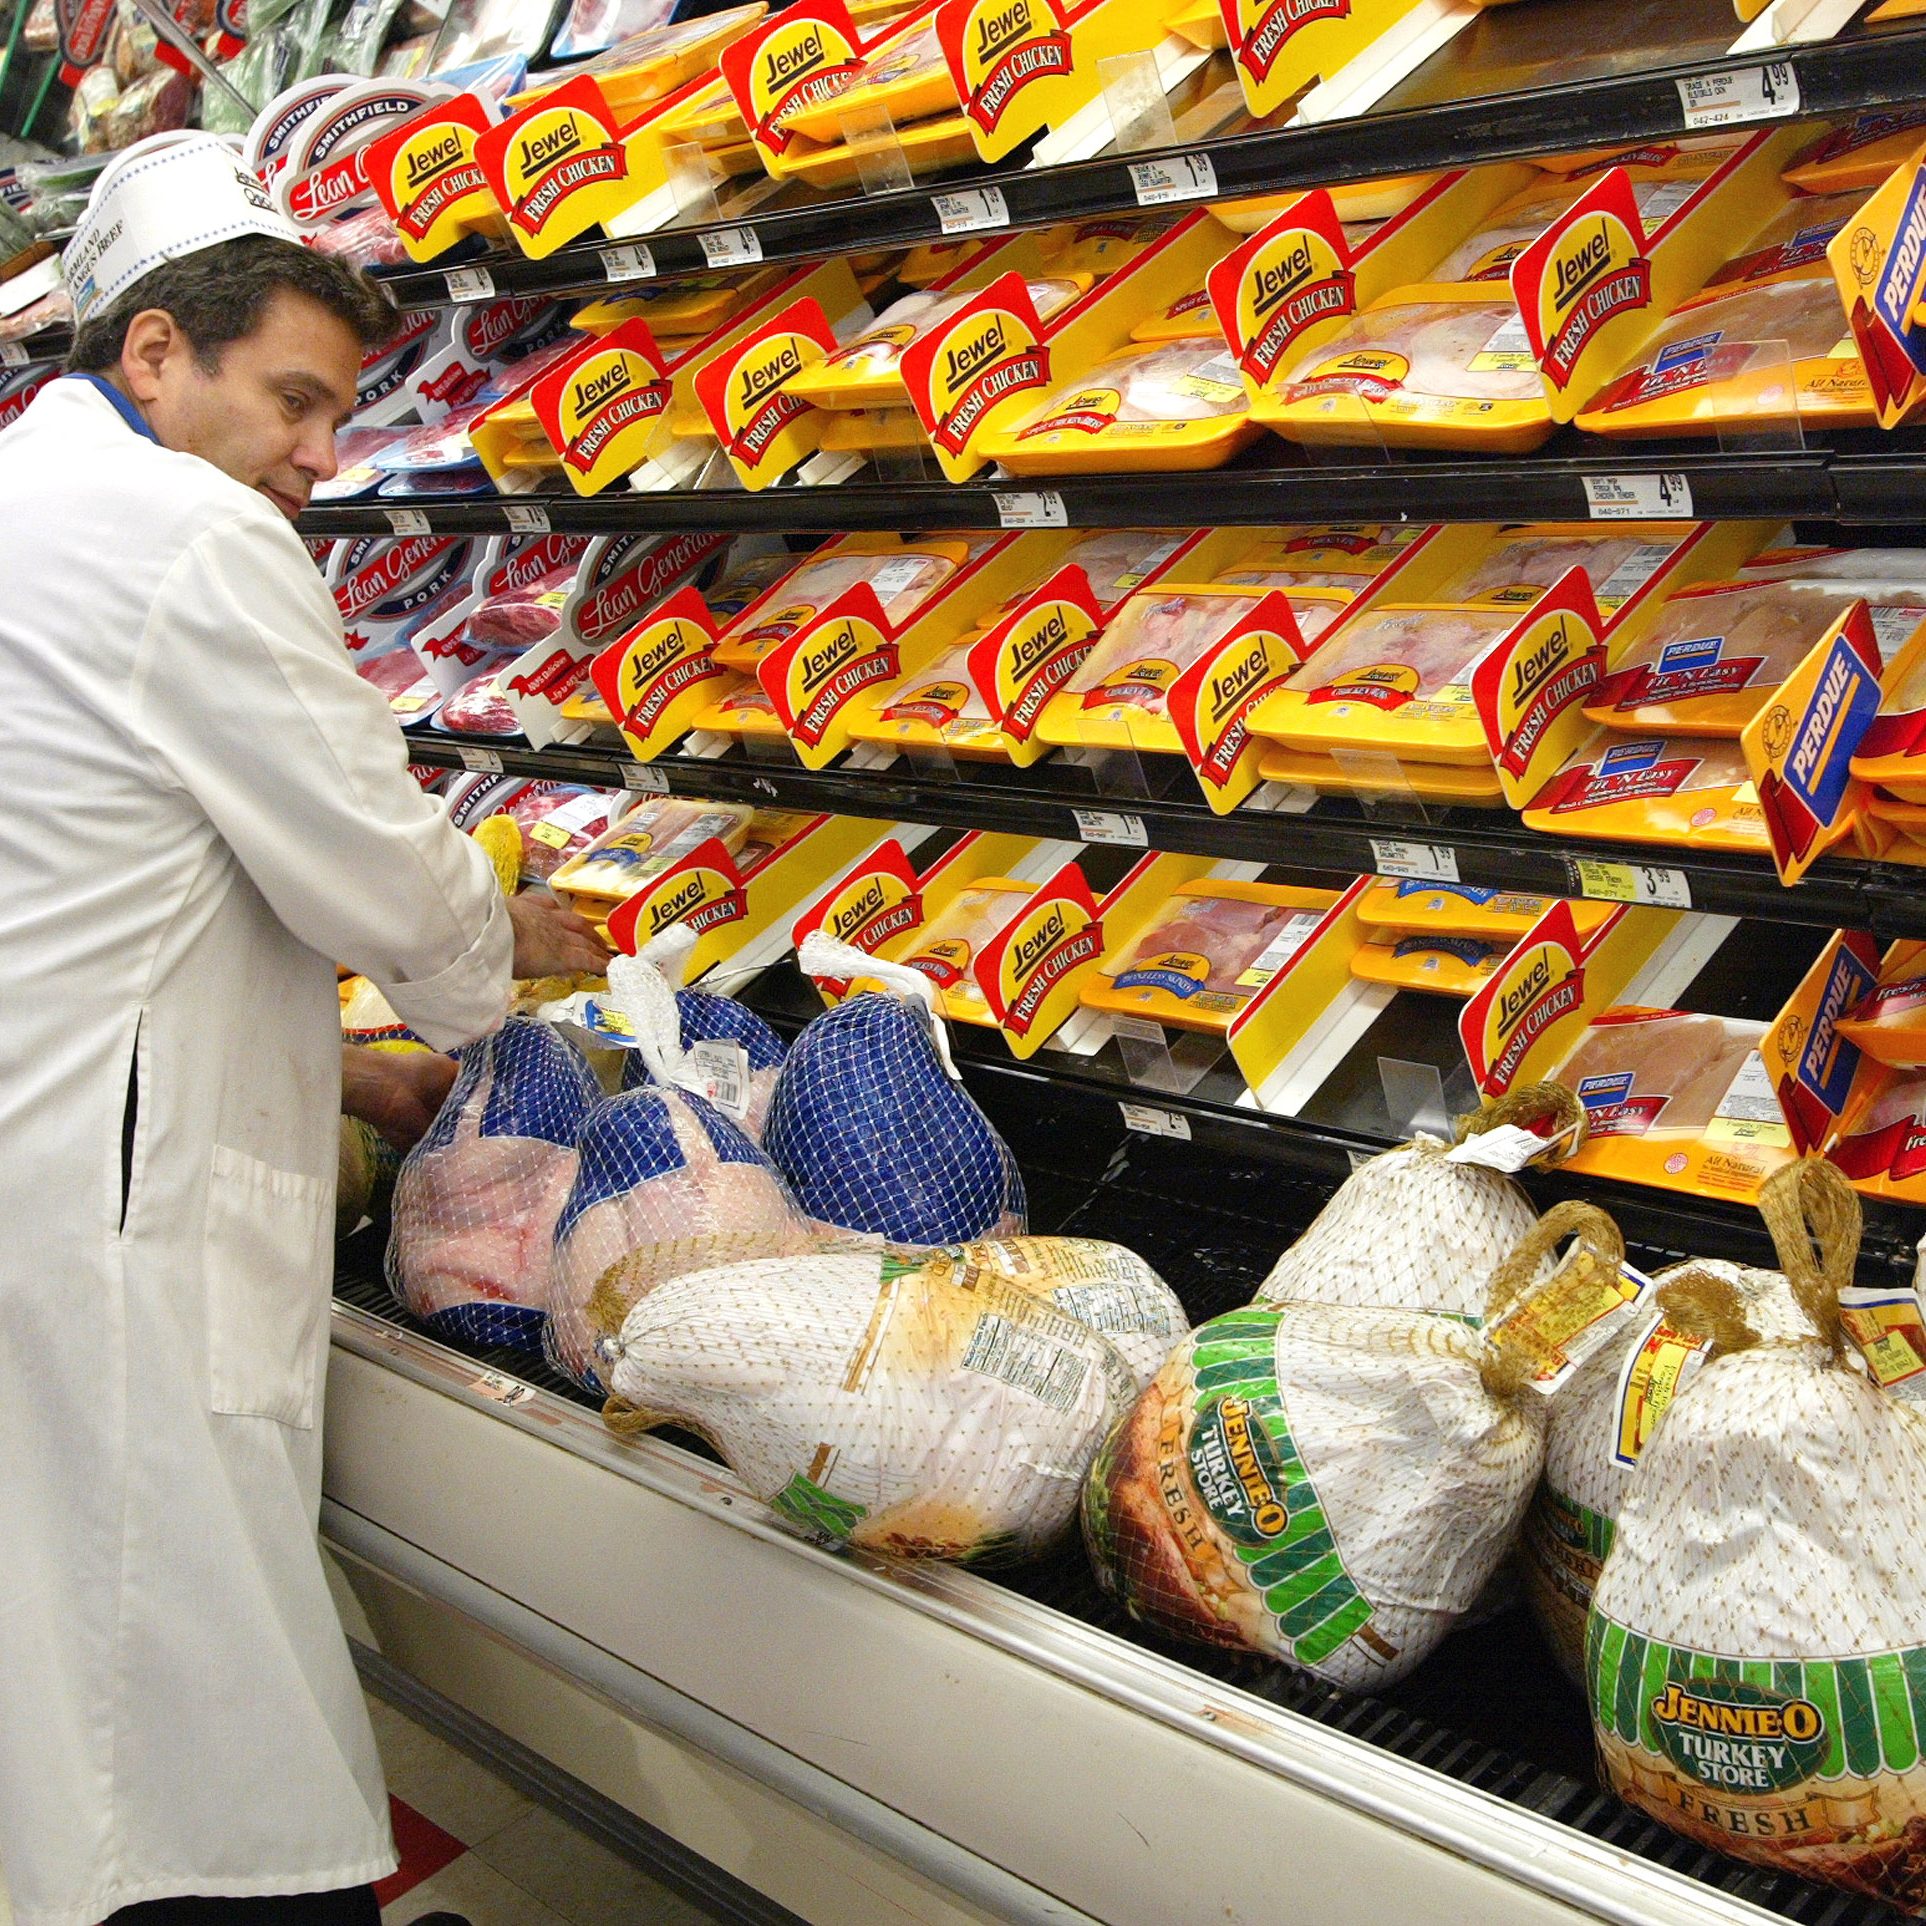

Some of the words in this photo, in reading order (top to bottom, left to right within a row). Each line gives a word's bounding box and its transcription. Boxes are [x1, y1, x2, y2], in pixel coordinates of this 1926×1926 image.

[766, 25, 822, 84] Jewel
[978, 0, 1030, 51] Jewel
[1251, 8, 1289, 66] FRESH
[979, 68, 1015, 118] FRESH
[1010, 45, 1062, 78] CHICKEN
[315, 100, 410, 159] SMITHFIELD
[520, 112, 579, 170] Jewel
[769, 93, 805, 141] FRESH
[407, 127, 462, 179] Jewel
[294, 163, 355, 220] Lean
[410, 186, 444, 229] FRESH
[524, 176, 561, 223] FRESH
[557, 154, 616, 188] CHICKEN
[1253, 235, 1312, 304] Jewel
[1554, 218, 1610, 300] Jewel
[472, 310, 512, 355] Lean
[945, 314, 1004, 382] Jewel
[1254, 318, 1292, 370] FRESH
[1288, 285, 1345, 327] CHICKEN
[1554, 310, 1590, 372] FRESH
[1586, 275, 1641, 321] CHICKEN
[574, 353, 629, 412] Jewel
[741, 337, 800, 400] Jewel
[576, 419, 612, 460] FRESH
[608, 390, 663, 426] CHICKEN
[743, 406, 782, 454] FRESH
[947, 393, 985, 442] FRESH
[981, 359, 1040, 400] CHICKEN
[338, 571, 388, 620] Lean
[403, 569, 452, 610] PORK
[582, 583, 638, 639] Lean
[632, 621, 683, 683] Jewel
[801, 620, 856, 683] Jewel
[1010, 605, 1066, 675] Jewel
[1513, 615, 1567, 698] Jewel
[1666, 639, 1720, 656] PERDUE
[804, 689, 839, 735] FRESH
[835, 655, 889, 696] CHICKEN
[1014, 678, 1049, 728] FRESH
[1045, 643, 1092, 688] CHICKE
[1211, 635, 1267, 711] Jewel
[635, 684, 667, 727] FRESH
[1513, 704, 1548, 763] FRESH
[1544, 661, 1599, 710] CHICKEN
[1794, 651, 1850, 784] PERDUE
[1212, 719, 1246, 772] FRESH
[1610, 745, 1660, 758] PERDUE
[650, 872, 704, 926] Jewel
[684, 901, 738, 931] HICKEN
[832, 877, 882, 937] Jewel
[863, 905, 914, 946] CHICKEN
[1014, 903, 1063, 973] Jewel
[1015, 973, 1047, 1022] FRESH
[1044, 935, 1095, 980] CHICKEN
[1498, 948, 1549, 1028] Jewel
[1495, 1029, 1528, 1086] FRESH
[1525, 984, 1576, 1035] CHICKEN
[1806, 959, 1850, 1081] PERDUE
[1584, 1075, 1629, 1092] PERDUE
[1722, 1156, 1766, 1174] Natural
[1159, 1439, 1204, 1549] FRESH
[1189, 1447, 1224, 1512] STORE
[1200, 1424, 1245, 1517] TURKEY
[1679, 1731, 1786, 1769] TURKEY
[1697, 1761, 1769, 1787] STORE
[1678, 1788, 1814, 1836] FRESH
